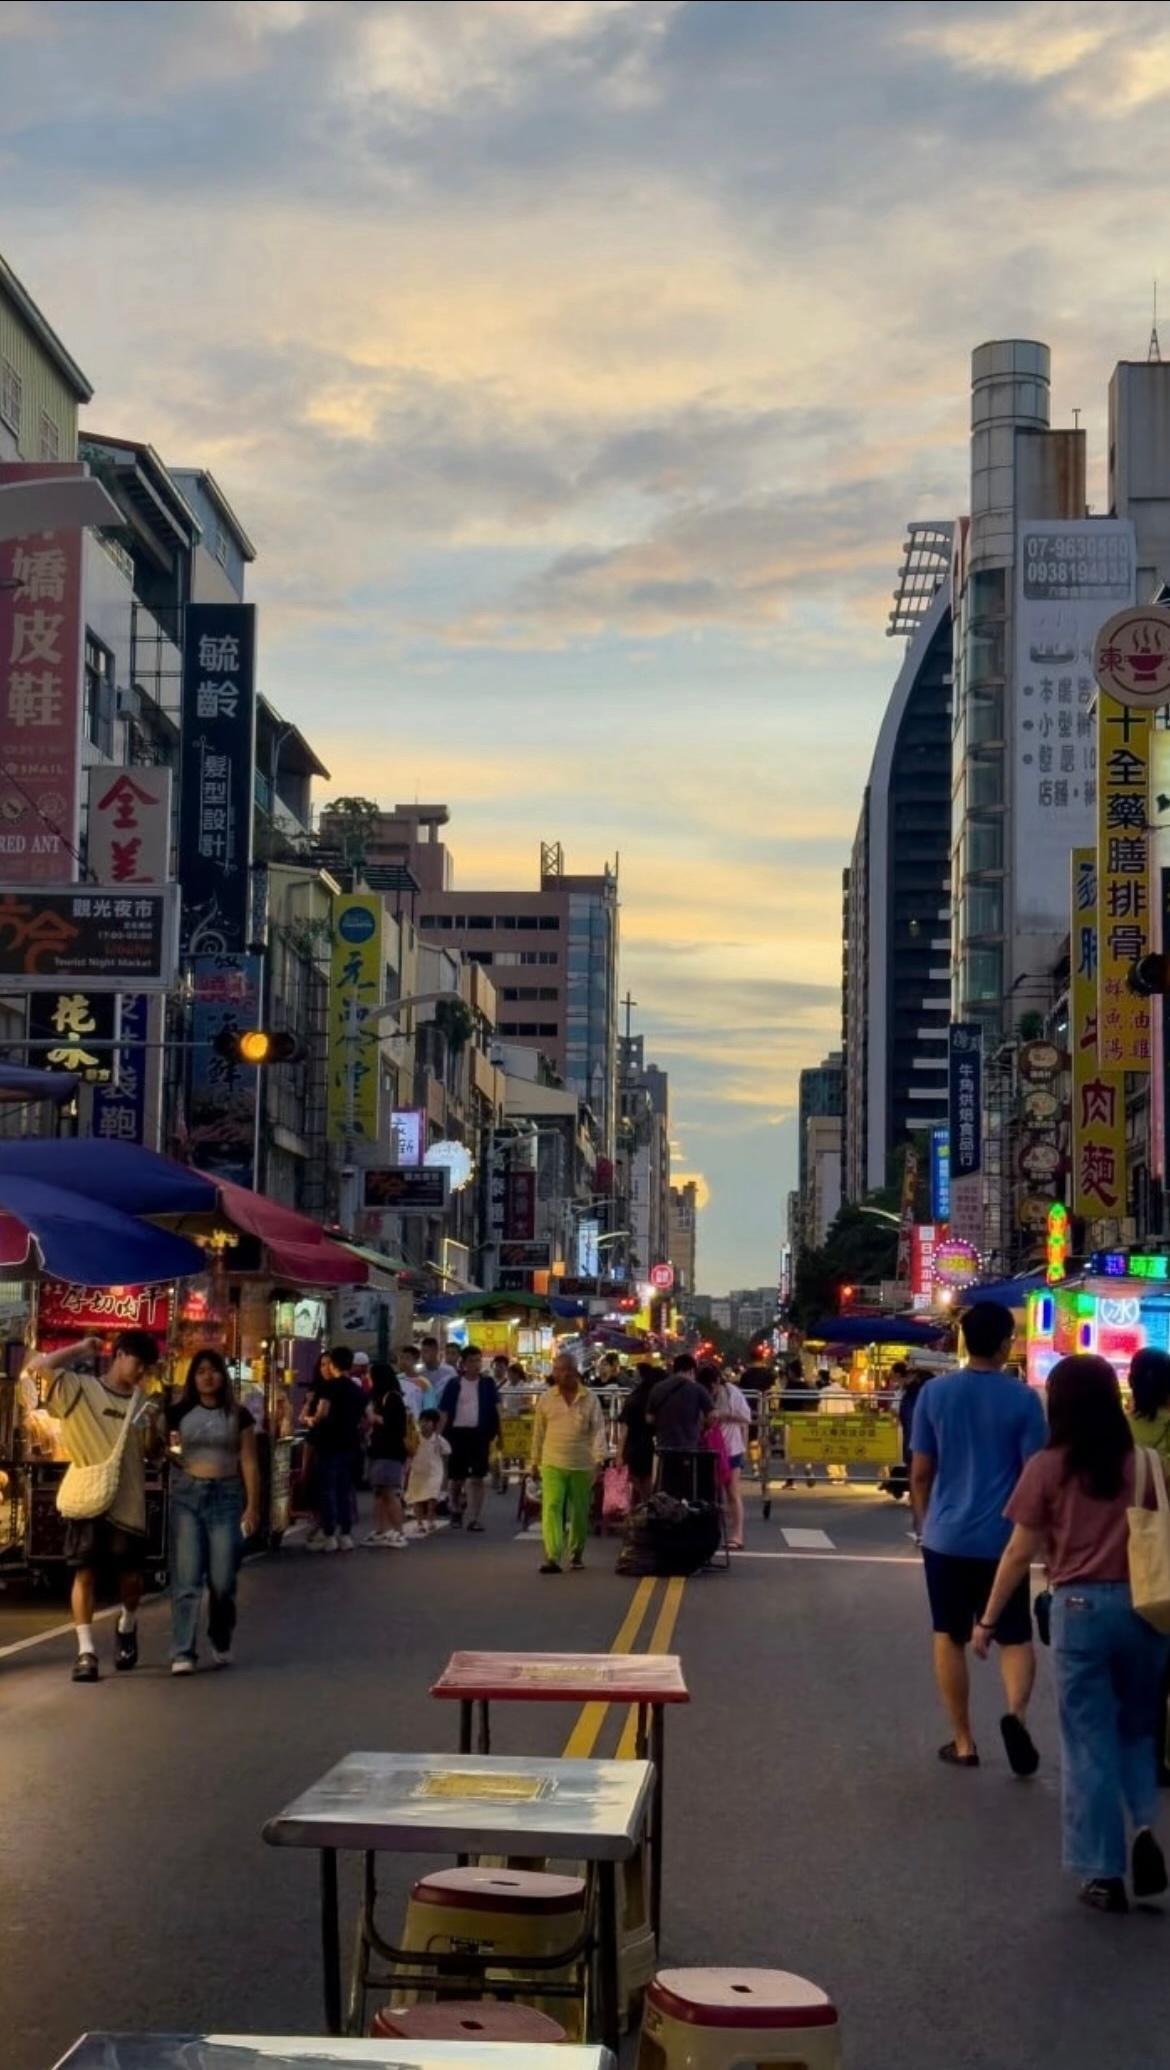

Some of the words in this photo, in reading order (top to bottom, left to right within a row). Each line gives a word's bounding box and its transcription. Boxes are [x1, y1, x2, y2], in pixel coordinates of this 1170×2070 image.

[8, 531, 66, 727] 嬌皮鞋
[197, 634, 241, 719] 毓齡
[31, 836, 61, 853] ANT
[201, 754, 227, 857] 髮型設計
[1105, 705, 1148, 961] 十全藥膳排骨
[72, 898, 152, 918] 觀光夜市
